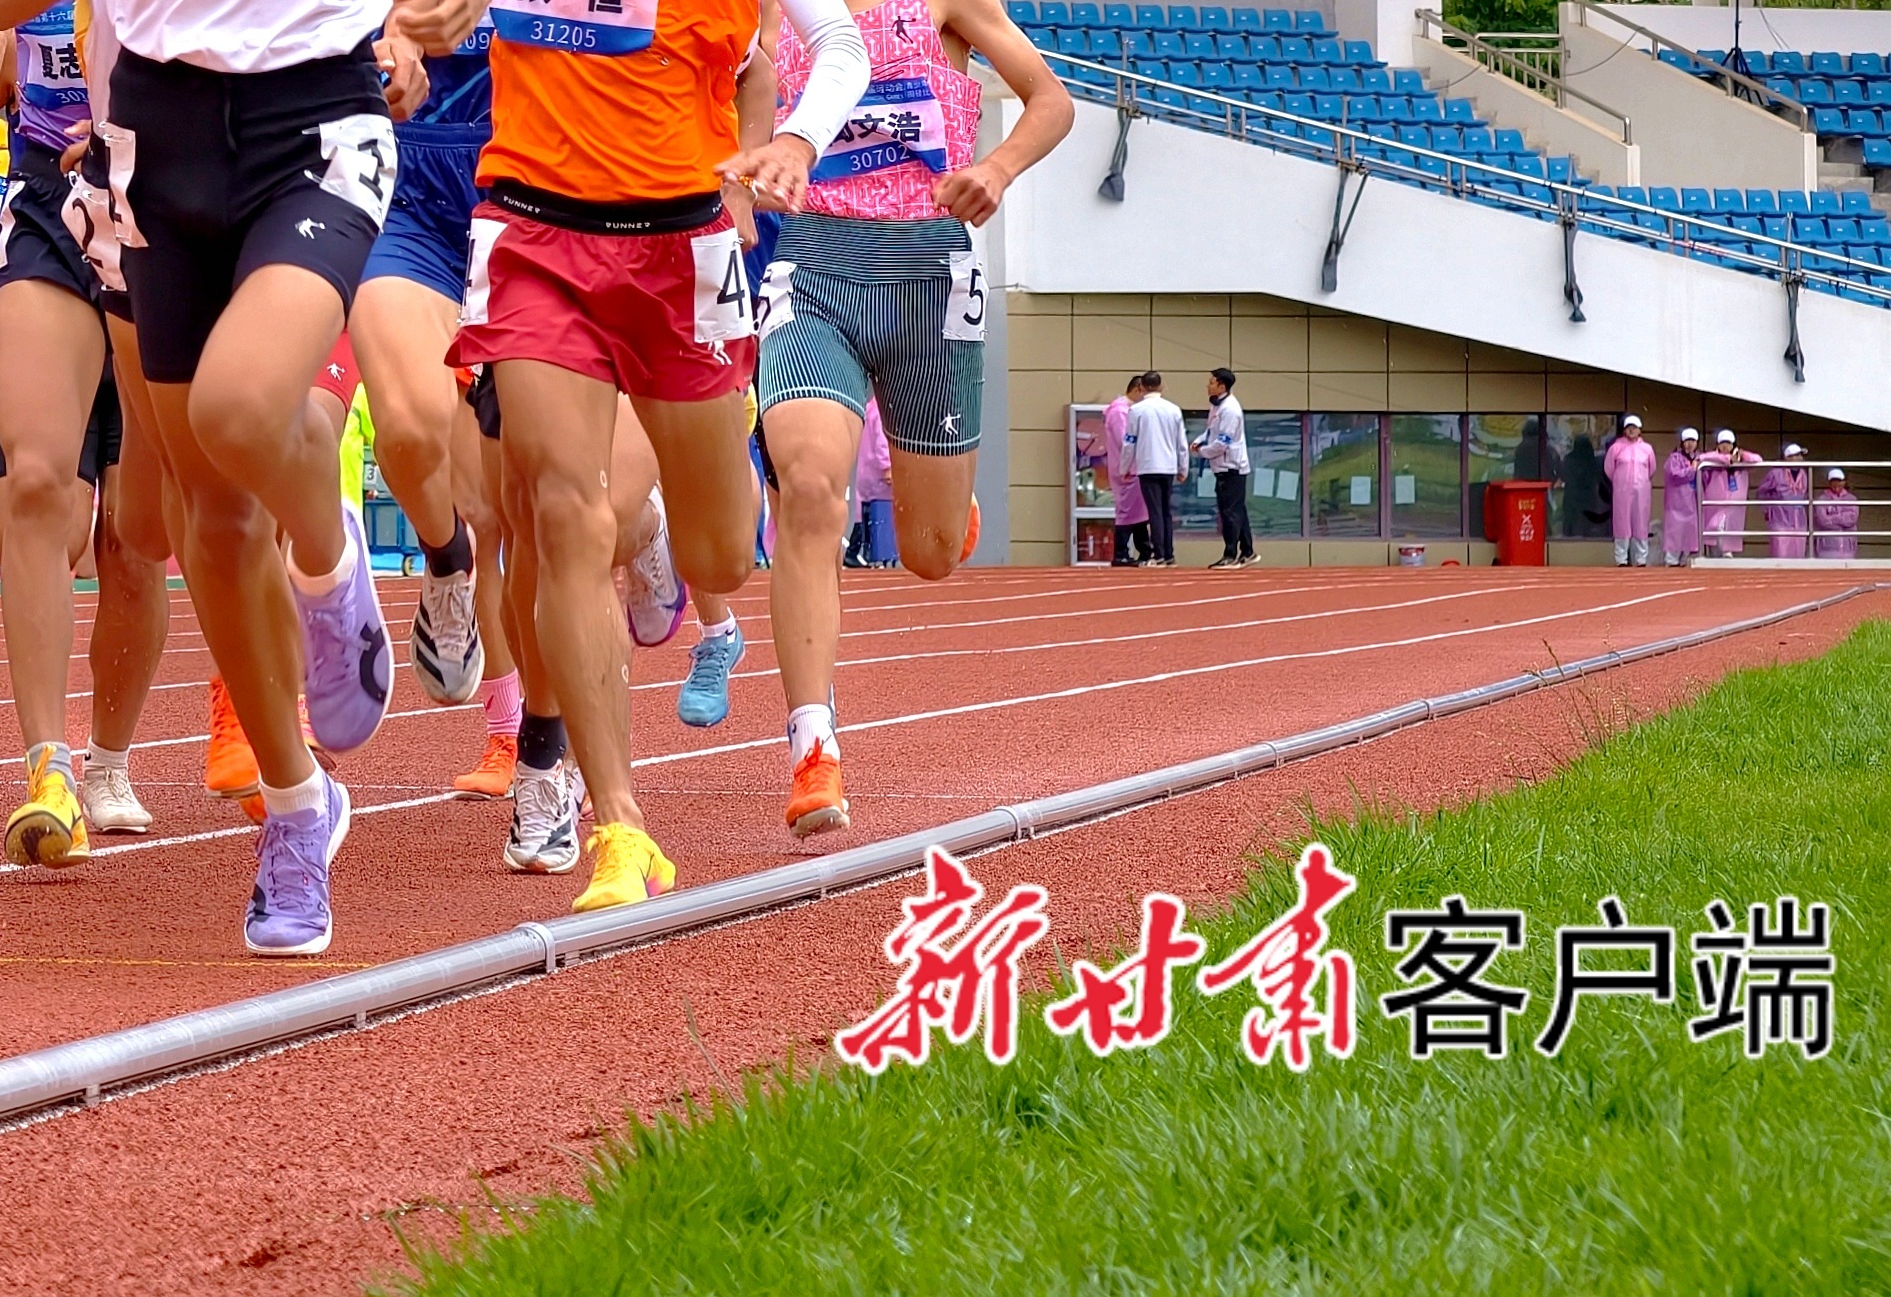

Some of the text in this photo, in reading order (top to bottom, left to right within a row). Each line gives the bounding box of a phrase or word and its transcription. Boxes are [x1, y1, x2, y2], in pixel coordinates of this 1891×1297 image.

[530, 21, 597, 48] 31205
[850, 145, 910, 171] 30702
[716, 250, 746, 319] 4
[963, 269, 984, 326] 5
